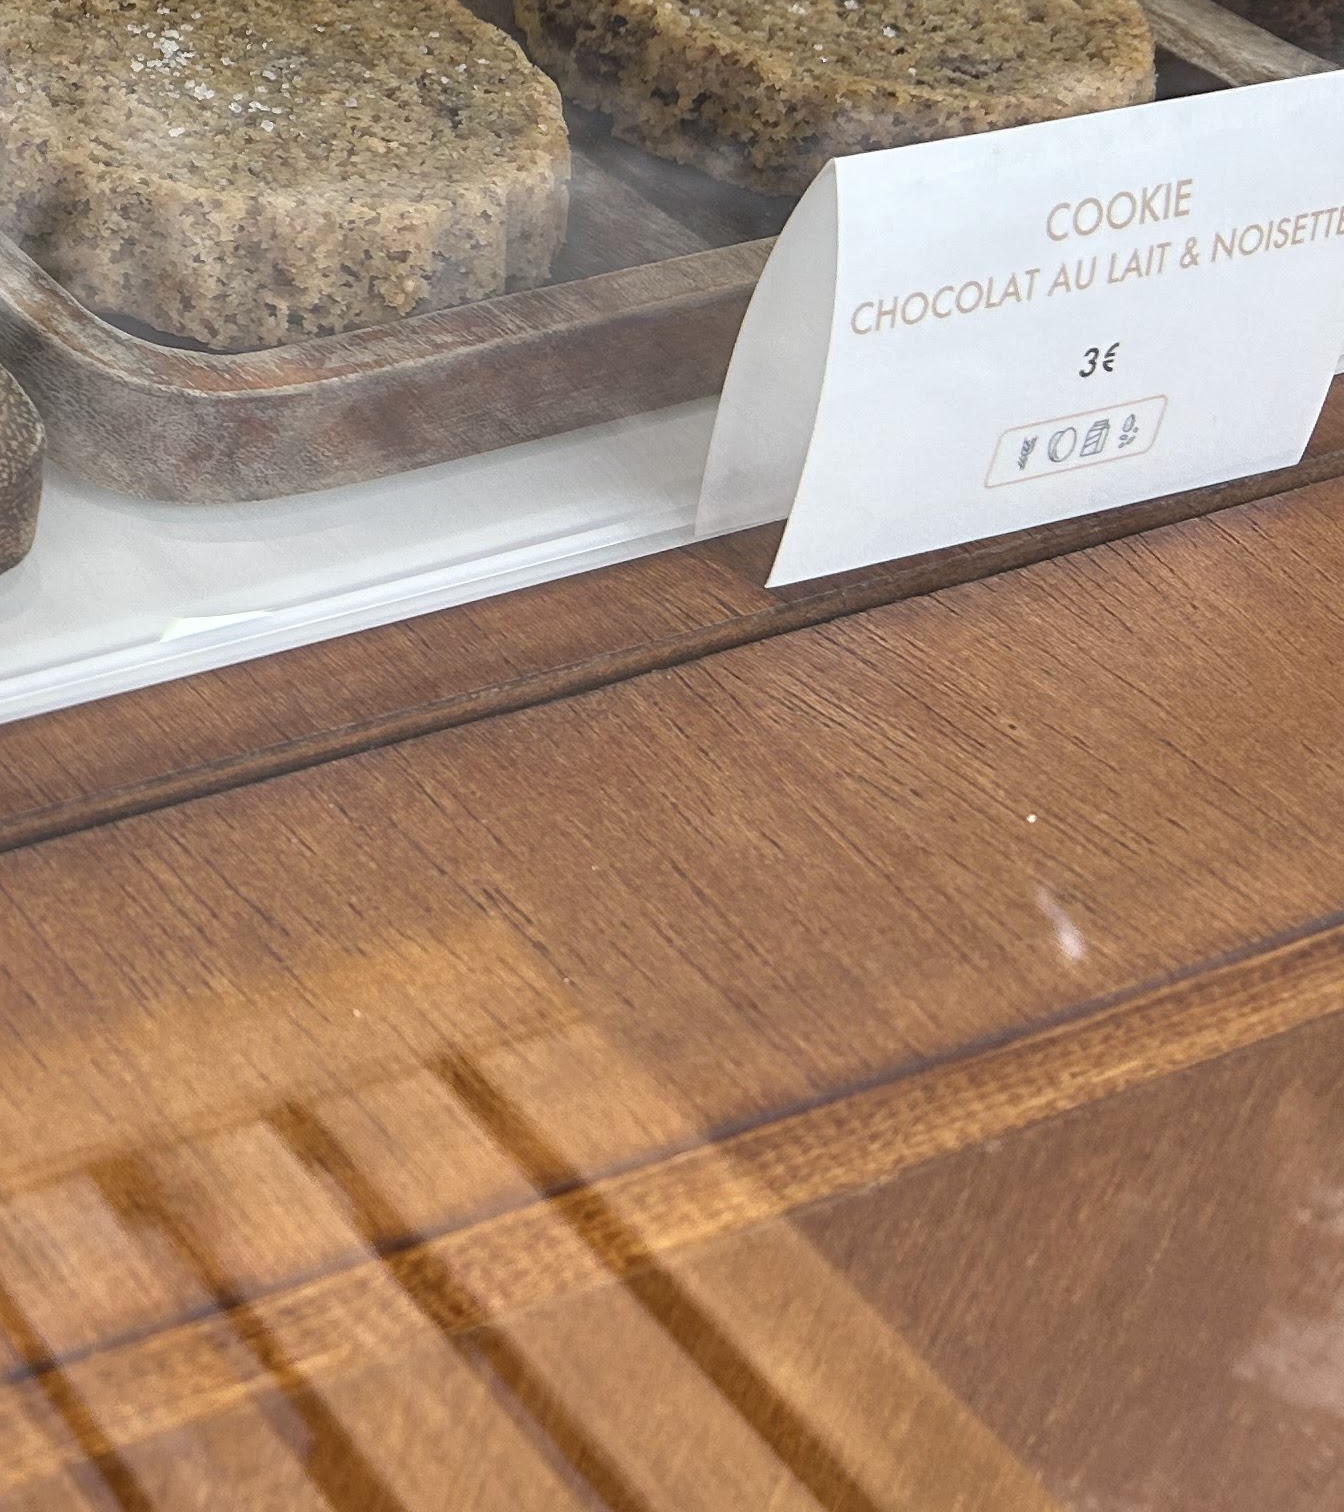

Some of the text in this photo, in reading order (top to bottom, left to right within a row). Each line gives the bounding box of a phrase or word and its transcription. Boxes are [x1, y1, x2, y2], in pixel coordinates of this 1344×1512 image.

[1046, 178, 1193, 241] COOKIE
[850, 268, 1040, 335] CHOCOLAT
[1047, 256, 1097, 297] AU
[1107, 241, 1172, 285] LAIT
[1179, 236, 1200, 269] &
